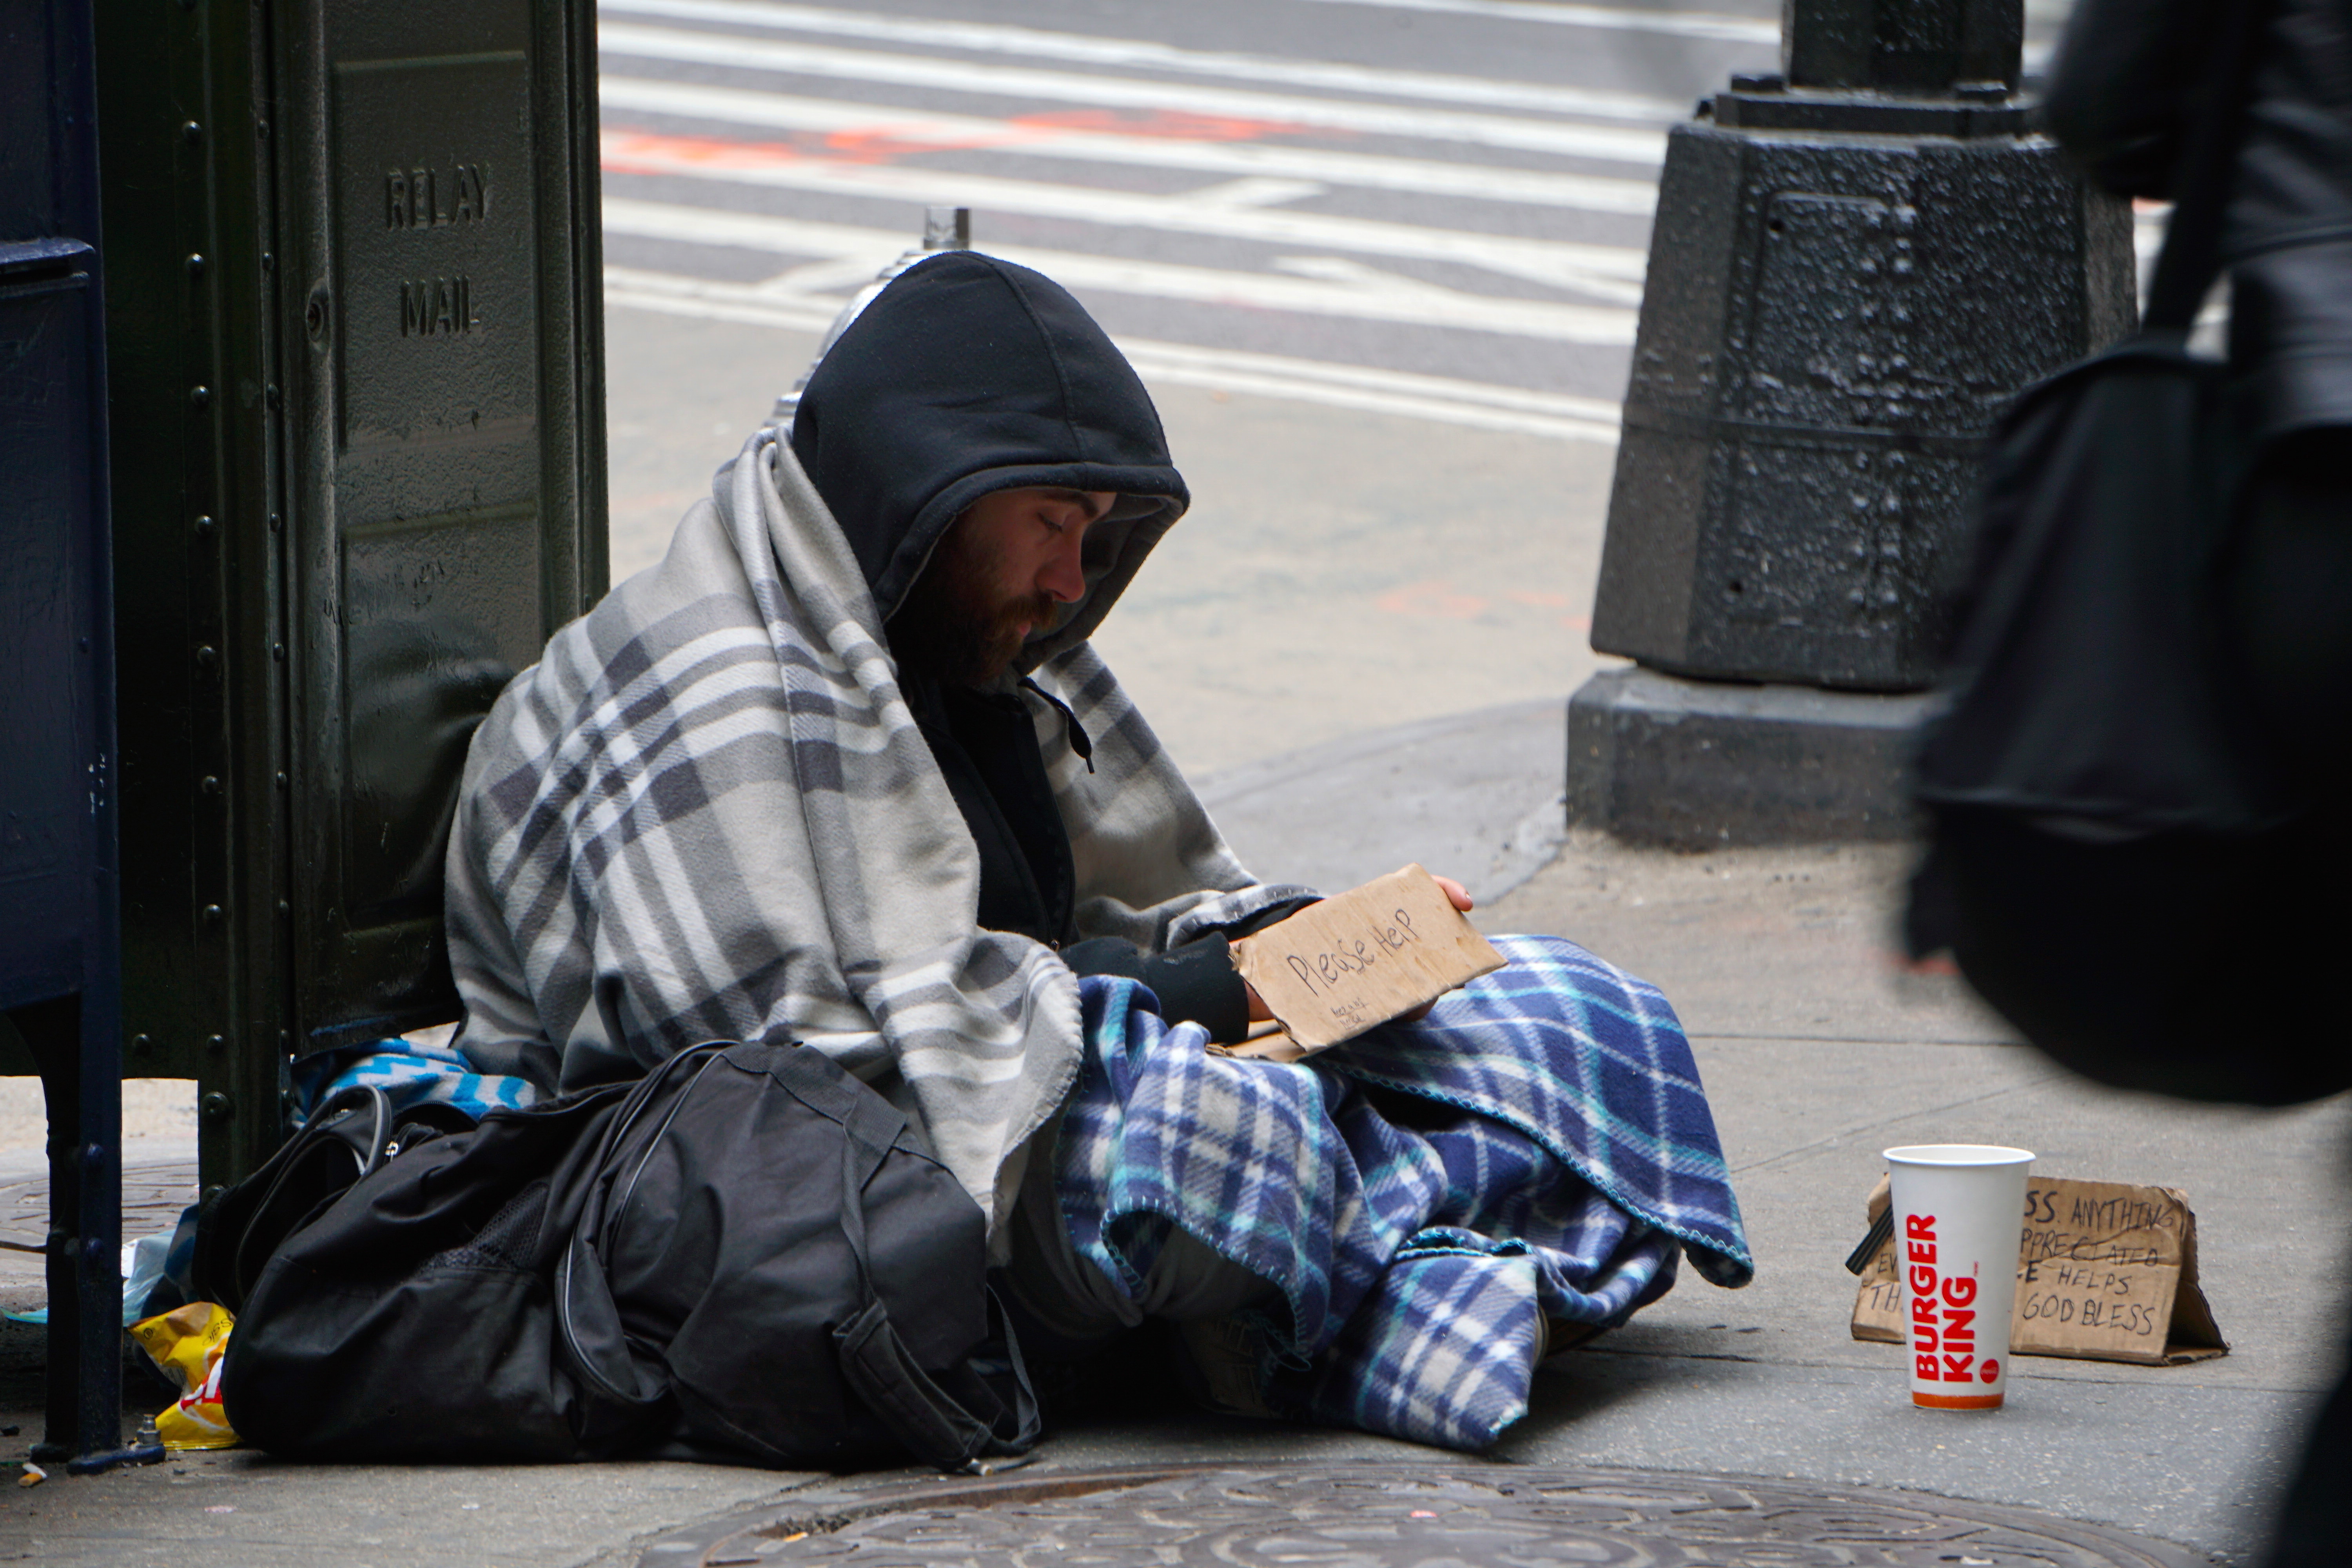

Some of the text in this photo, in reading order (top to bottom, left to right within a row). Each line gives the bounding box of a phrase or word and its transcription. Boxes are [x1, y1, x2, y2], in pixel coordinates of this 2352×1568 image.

[385, 163, 493, 230] RELAY
[400, 276, 483, 339] MAIL
[2071, 1197, 2174, 1232] ANYTHING
[2021, 1228, 2159, 1267] PPRECIATED
[1907, 1214, 1940, 1381] BURGER
[1942, 1276, 1977, 1382] KING
[2023, 1293, 2074, 1323] GOD
[2081, 1299, 2156, 1336] BLESS
